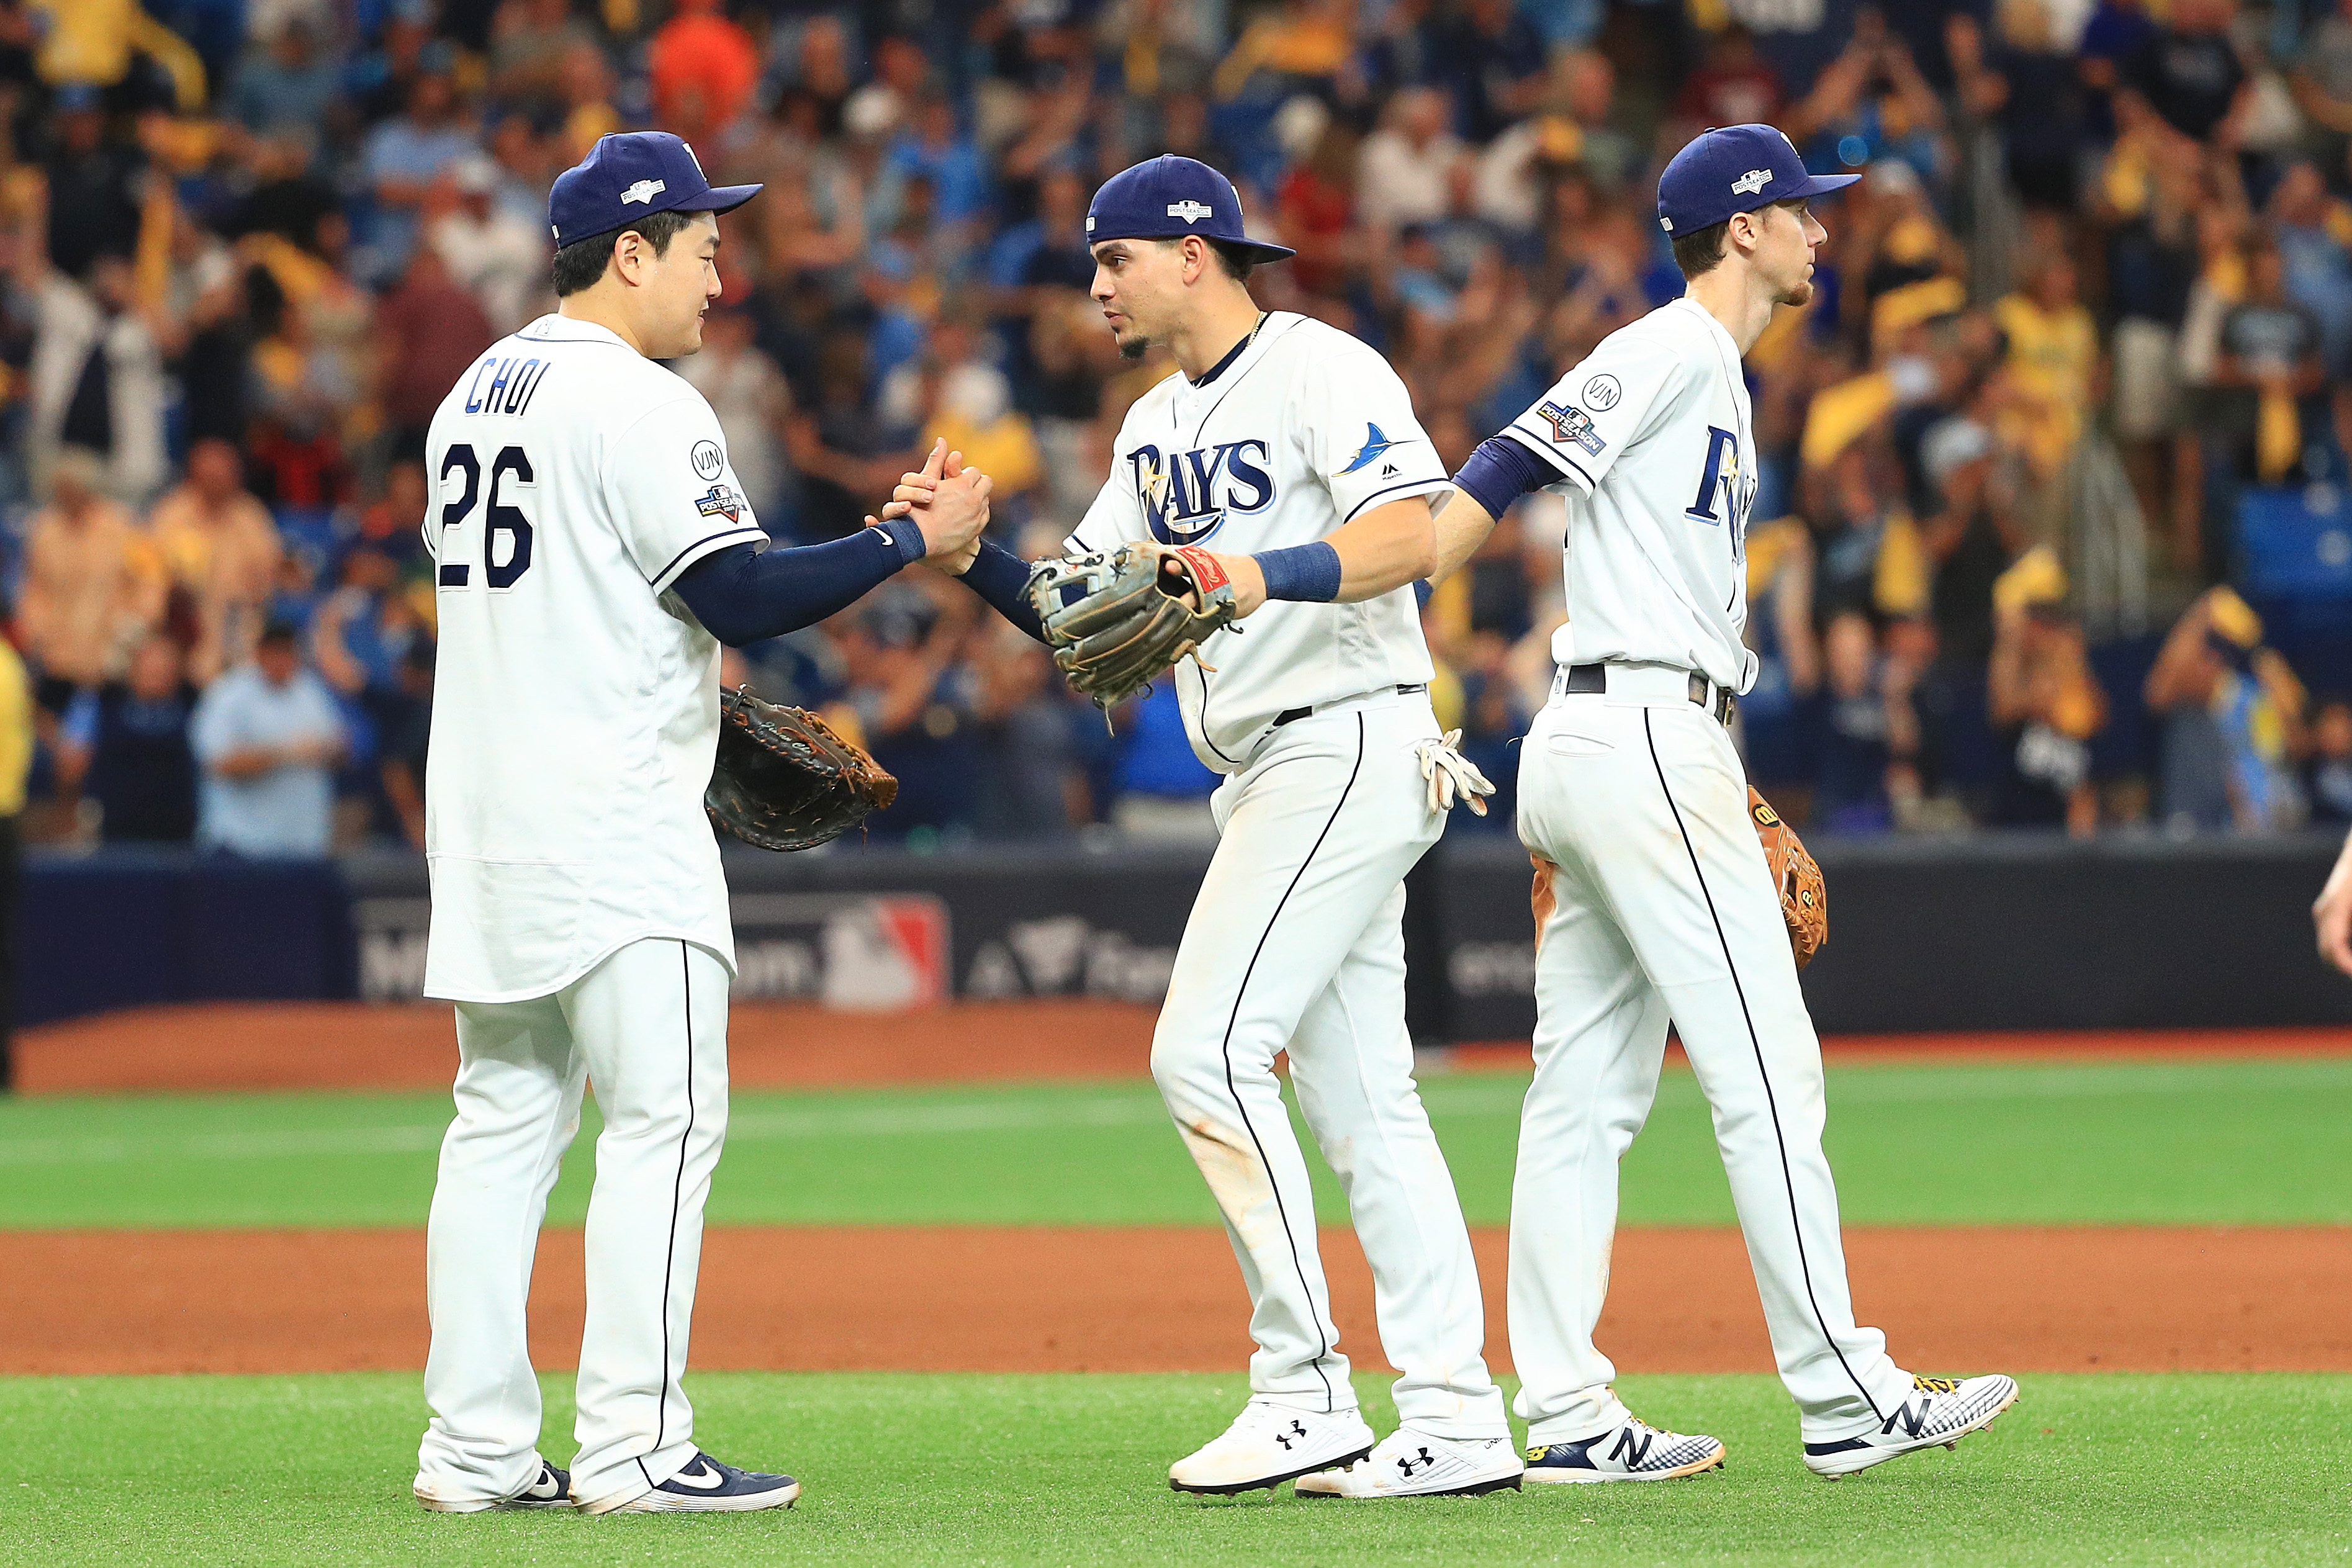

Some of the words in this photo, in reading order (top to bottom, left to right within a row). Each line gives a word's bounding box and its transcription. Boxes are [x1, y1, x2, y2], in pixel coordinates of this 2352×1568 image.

[623, 184, 662, 201] POSTSEASON
[1734, 174, 1770, 191] POSTSEASON
[465, 357, 552, 417] CHOI
[1589, 379, 1618, 407] VJN
[1541, 405, 1600, 451] POSTSEASON
[1558, 425, 1573, 436] 2019
[694, 448, 720, 471] VJN
[1126, 439, 1276, 546] RAYS
[439, 443, 534, 590] 26
